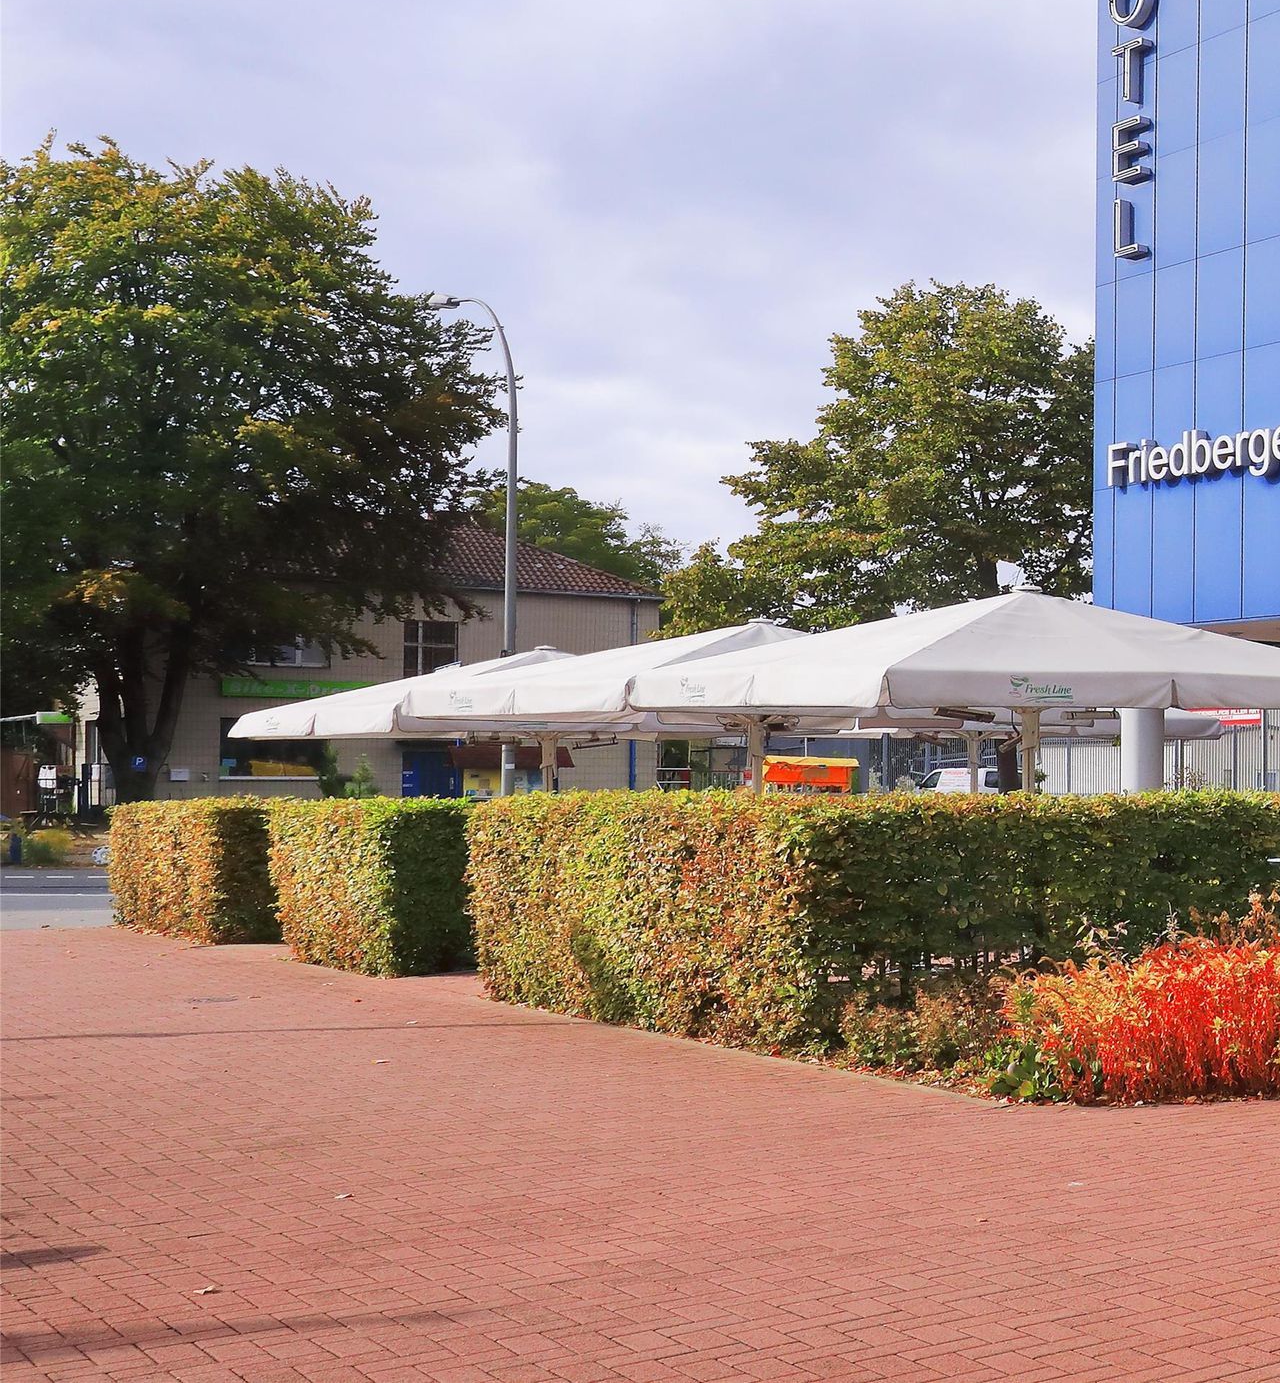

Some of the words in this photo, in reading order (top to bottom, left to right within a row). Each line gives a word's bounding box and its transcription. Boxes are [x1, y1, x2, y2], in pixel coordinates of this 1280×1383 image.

[1025, 684, 1051, 695] Fresh
[1053, 684, 1072, 695] Line
[135, 757, 144, 766] P
